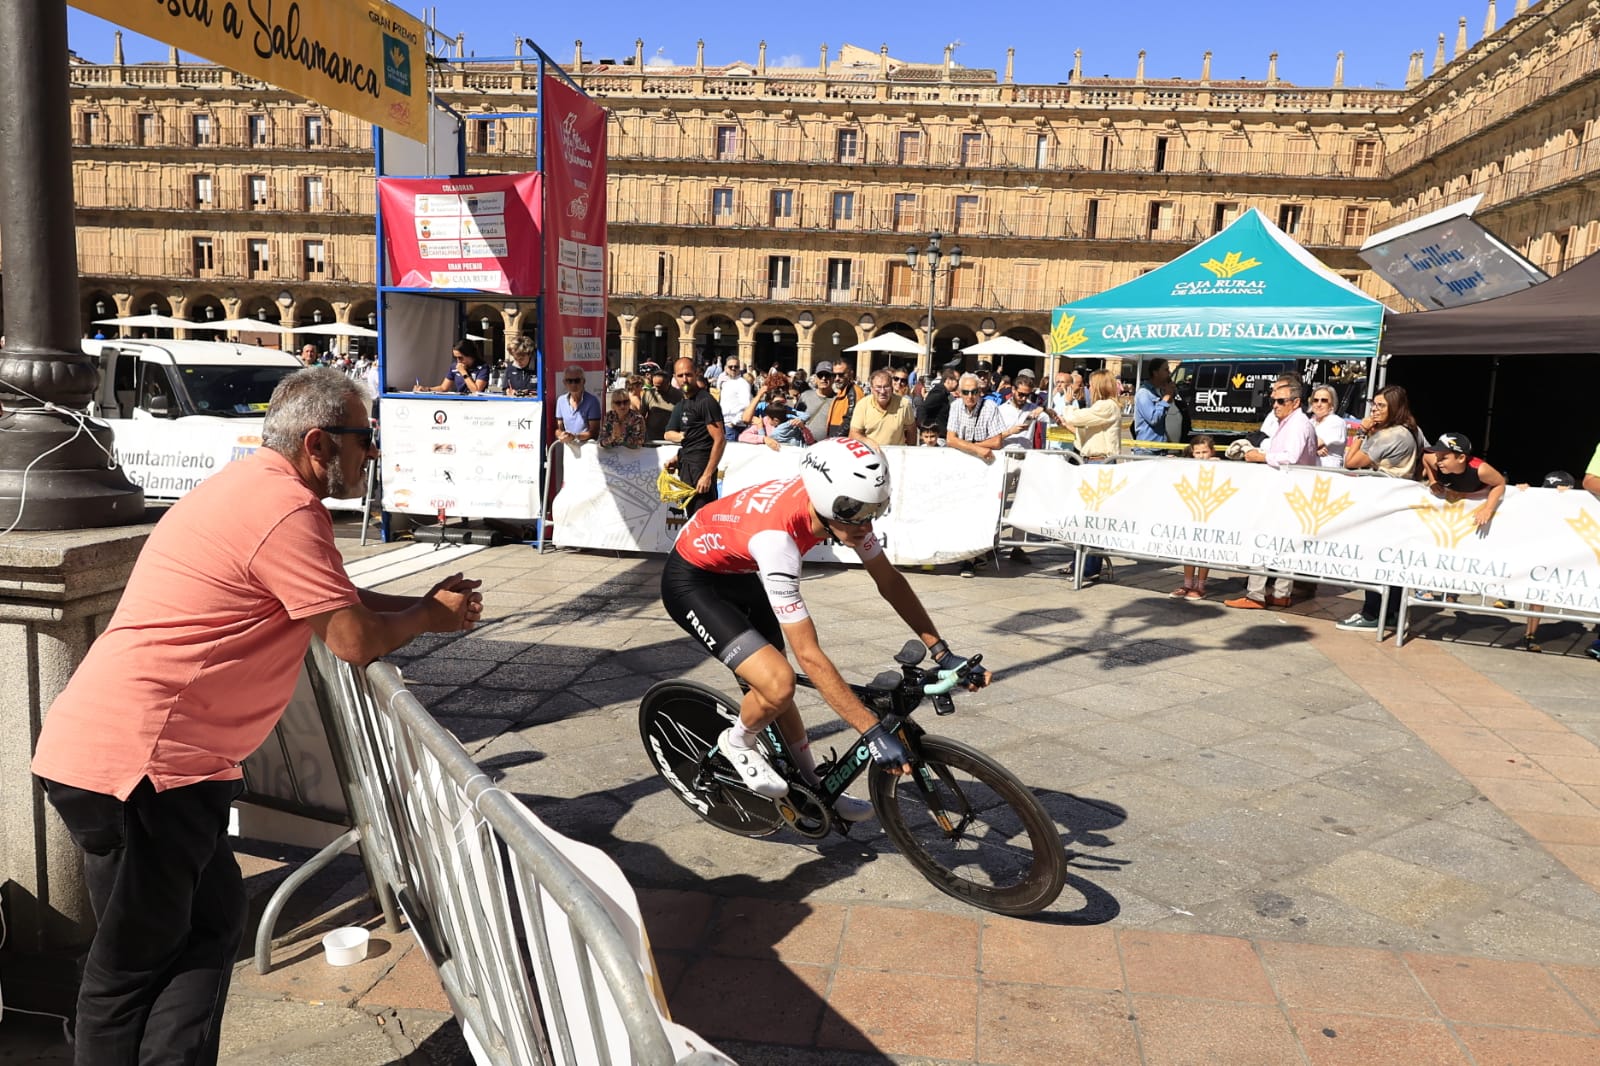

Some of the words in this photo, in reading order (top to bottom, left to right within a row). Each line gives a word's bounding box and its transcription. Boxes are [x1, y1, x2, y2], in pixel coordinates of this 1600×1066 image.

[368, 10, 391, 30] GRAN
[392, 21, 417, 45] PREMIO
[223, 2, 243, 39] a
[247, 0, 381, 98] Salamanca
[1175, 280, 1211, 290] CAJA
[1214, 279, 1266, 288] RURAL
[1102, 324, 1143, 342] CAJA
[1147, 323, 1203, 338] RURAL
[1208, 323, 1231, 338] DE
[1235, 323, 1356, 339] SALAMANCA
[1196, 389, 1227, 406] EKT
[128, 470, 206, 491] Salamanc
[1085, 515, 1140, 535] RURAL
[1150, 523, 1187, 543] CAJA
[1193, 527, 1242, 546] RURAL
[1147, 541, 1162, 553] DE
[1165, 543, 1239, 562] SALAMANCA
[1254, 533, 1296, 556] CAJA
[1302, 539, 1364, 561] RURAL
[1252, 552, 1269, 564] DE
[1271, 556, 1360, 578] SALAMANCA
[1378, 547, 1428, 570] CAJA
[1436, 553, 1512, 579] RURAL
[1374, 568, 1396, 582] DE
[1398, 569, 1507, 597] SALAMANCA
[1530, 565, 1588, 591] CAJA
[1526, 587, 1550, 602] DE
[686, 609, 717, 651] FROIZ
[868, 741, 883, 761] ROIZ
[824, 745, 870, 795] Bianc
